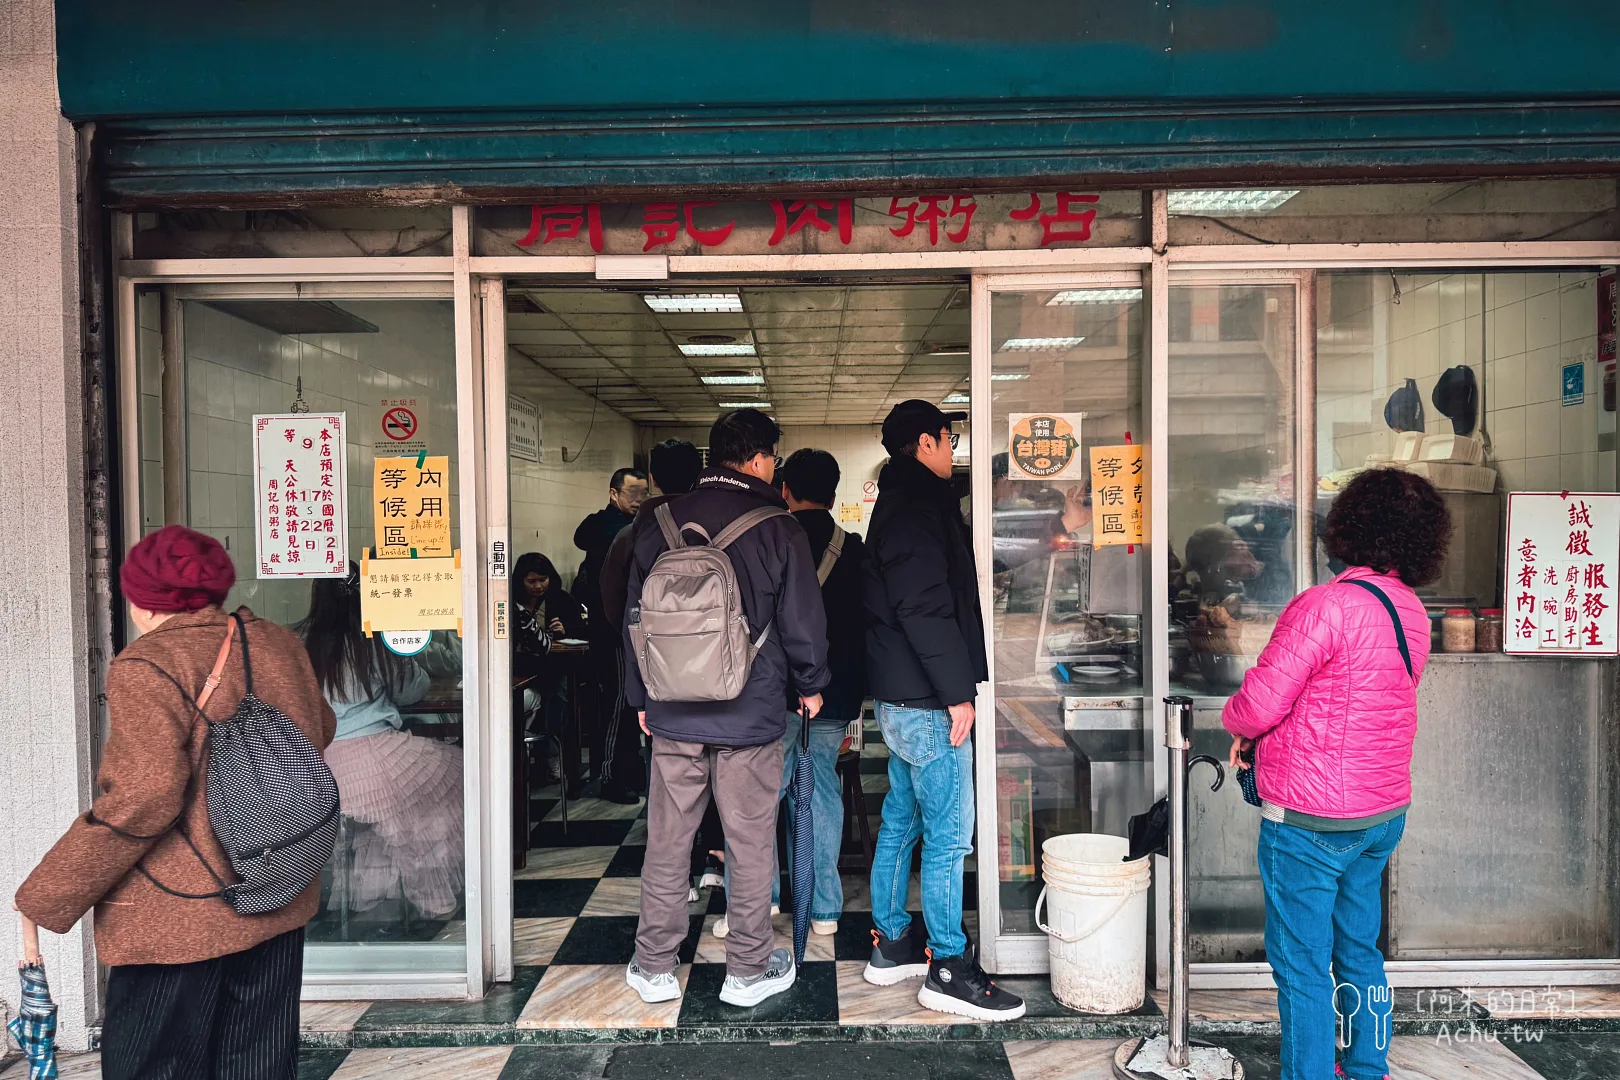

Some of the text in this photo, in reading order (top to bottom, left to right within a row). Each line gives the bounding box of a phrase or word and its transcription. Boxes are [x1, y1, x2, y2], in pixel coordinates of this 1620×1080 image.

[1035, 420, 1049, 428] 本店
[1035, 429, 1049, 437] 使用
[1017, 439, 1067, 457] 台灣豬
[1022, 462, 1063, 475] TAIWAN PORK
[719, 476, 750, 490] Anderson
[1097, 457, 1126, 534] 等候區
[379, 468, 409, 547] 等候區
[379, 546, 410, 557] Inside!
[493, 540, 505, 574] 自動門
[370, 587, 413, 598] 統一發票
[1543, 565, 1558, 643] 洗碗工
[1564, 565, 1580, 644] 廚房助手
[1582, 563, 1610, 645] 服務生
[392, 637, 422, 645] 合作店家
[763, 969, 780, 979] HOKA
